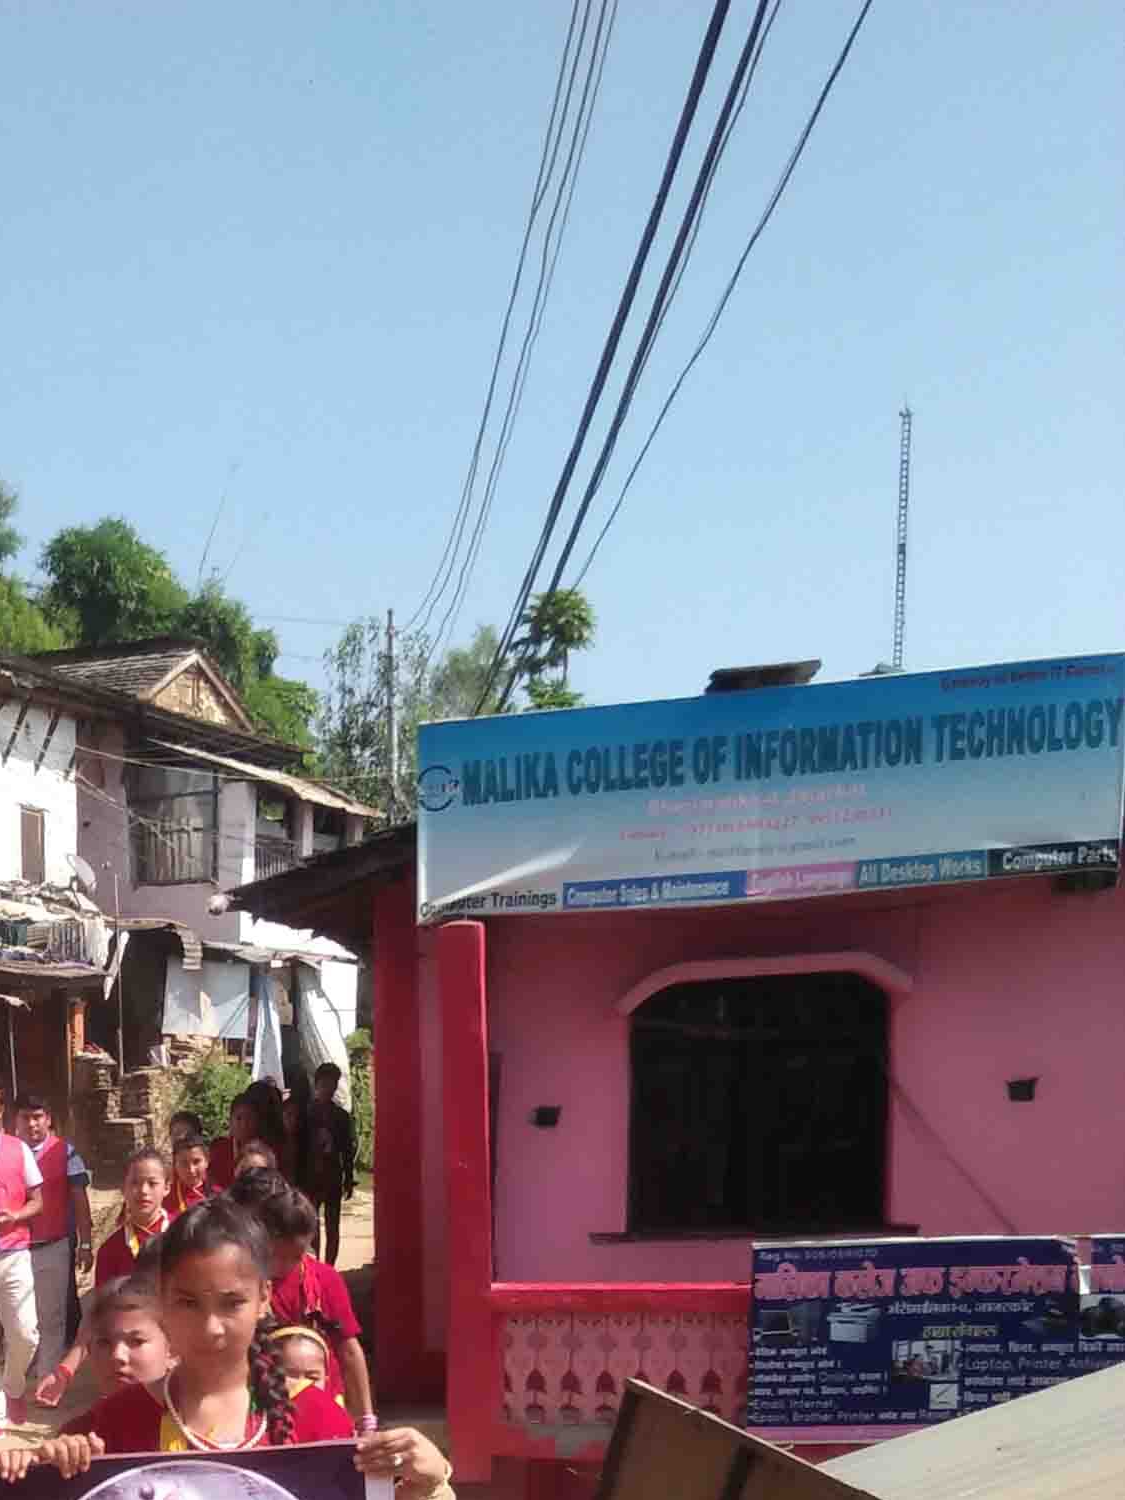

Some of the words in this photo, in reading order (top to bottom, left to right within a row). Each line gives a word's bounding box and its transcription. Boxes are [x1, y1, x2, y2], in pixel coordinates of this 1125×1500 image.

[459, 750, 561, 808] MALIKA
[565, 739, 686, 797] COLLEGE
[692, 734, 727, 786] OF
[734, 717, 923, 781] INFORMATION
[931, 696, 1124, 763] TECHNOLOGY
[938, 857, 981, 878] Works
[1001, 849, 1073, 872] Computer
[1077, 846, 1116, 866] Parts
[490, 888, 558, 909] Trainings
